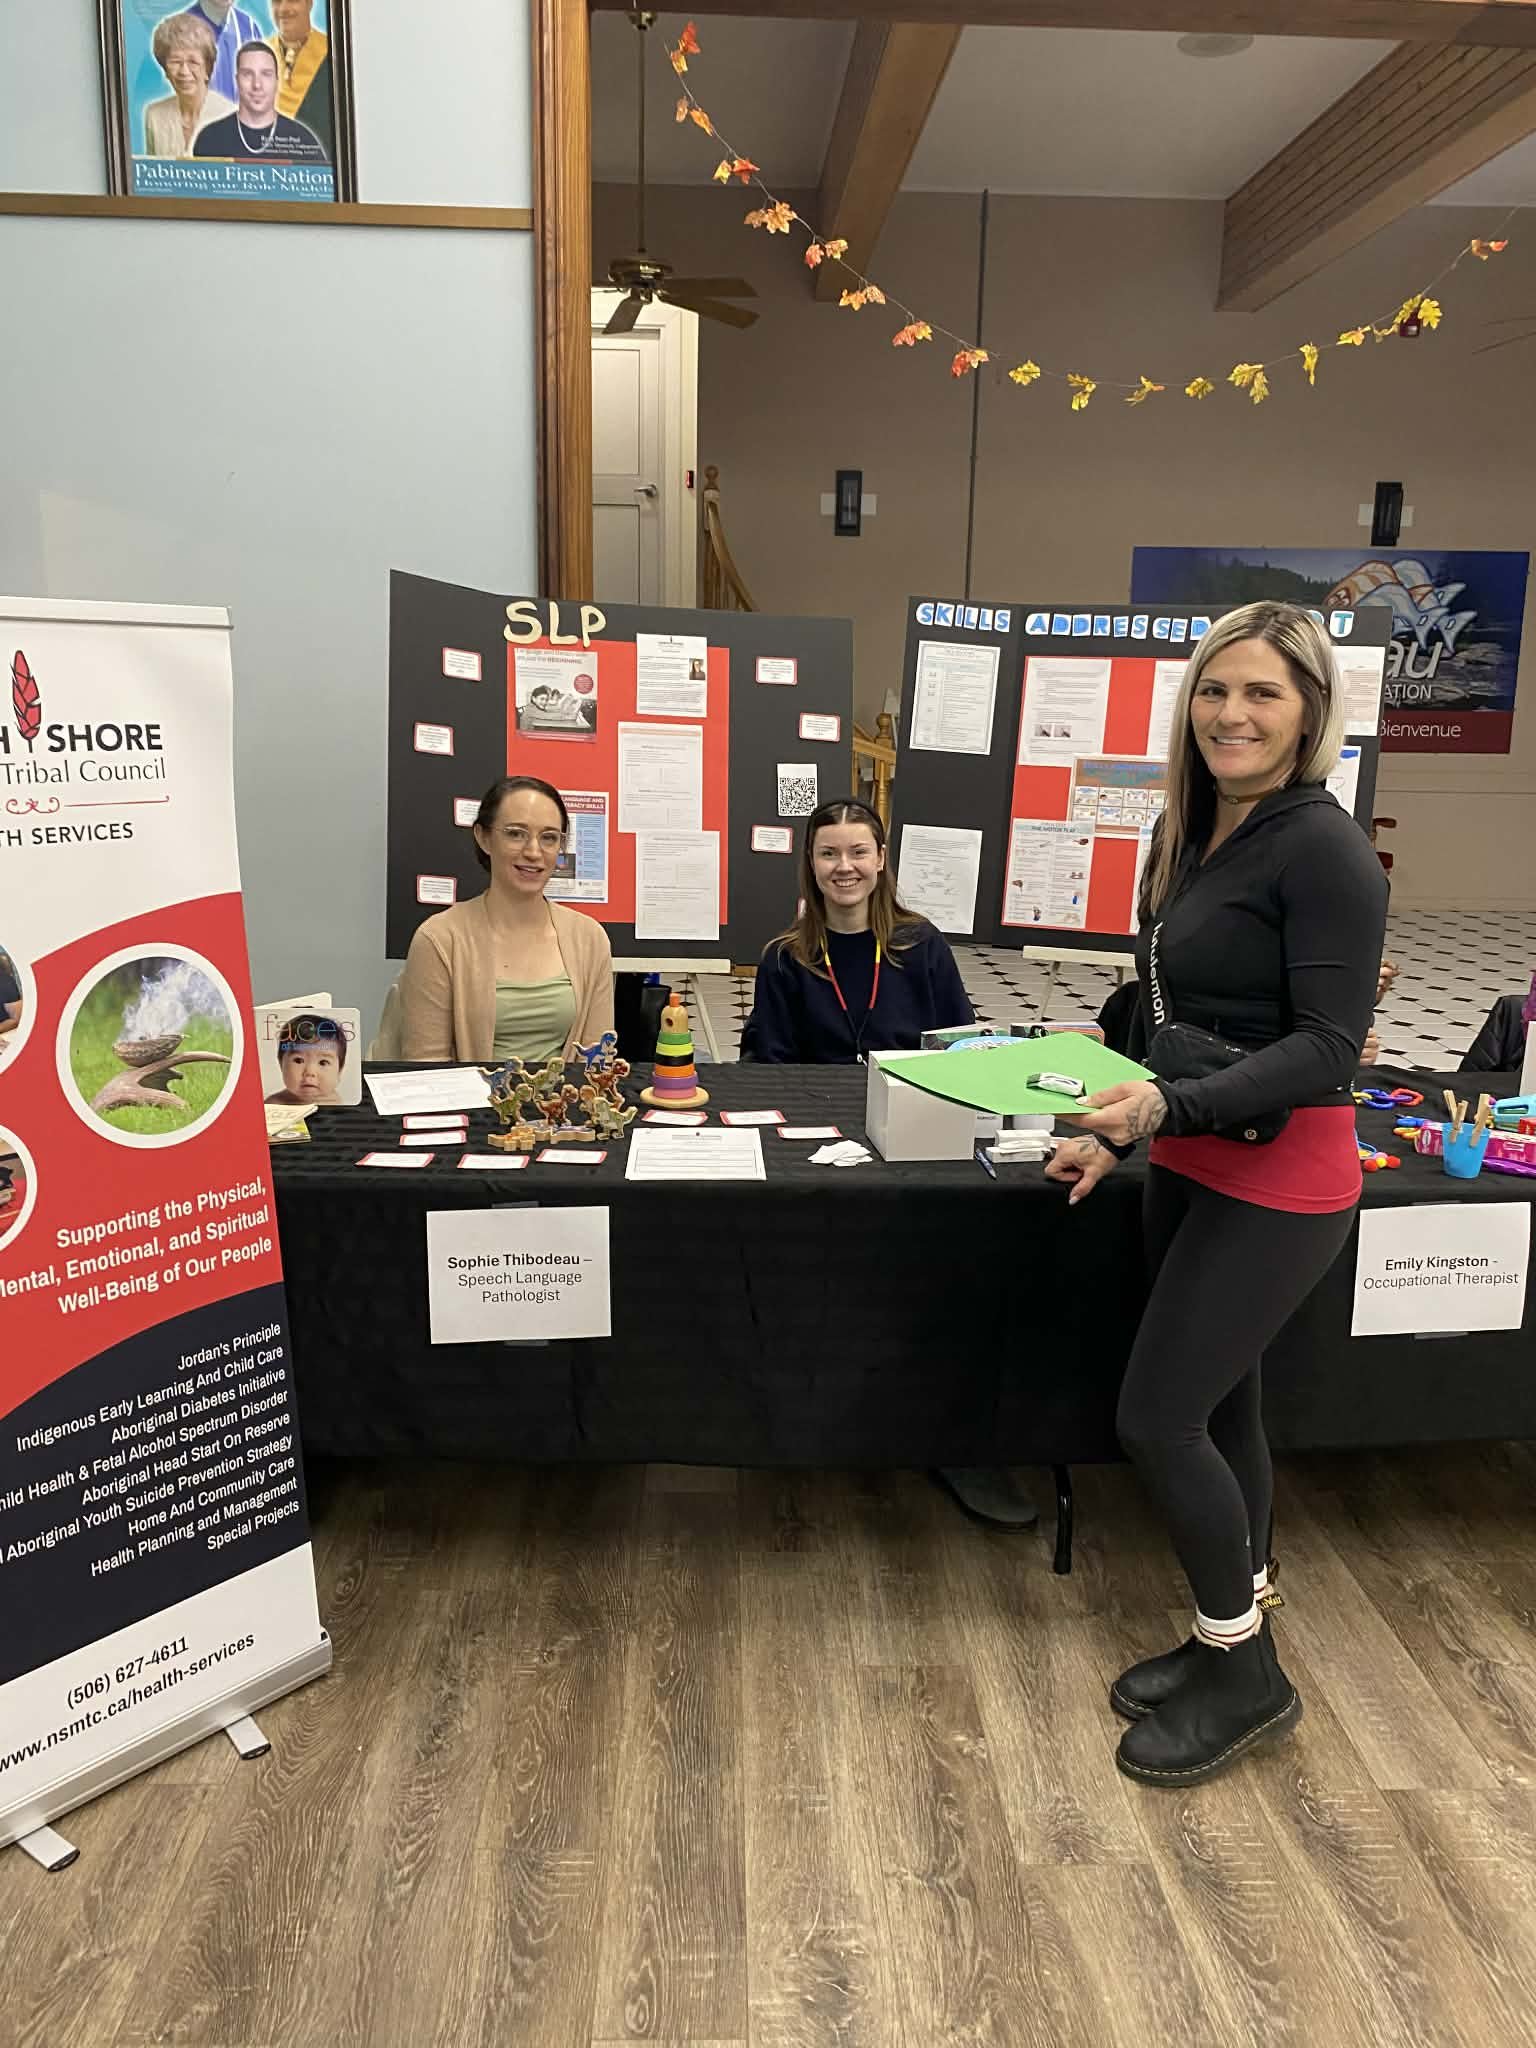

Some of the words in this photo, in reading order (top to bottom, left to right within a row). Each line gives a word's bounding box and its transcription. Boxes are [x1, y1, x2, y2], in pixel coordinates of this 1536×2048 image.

[135, 163, 218, 183] Pabineau
[225, 166, 264, 182] First
[272, 167, 334, 185] Nation
[503, 600, 607, 648] SLP
[919, 604, 1010, 631] SKILLS
[1029, 614, 1207, 641] ADDRESSED
[1384, 684, 1432, 699] ATION
[47, 723, 163, 753] SHORE
[0, 759, 70, 785] Tribal
[79, 757, 166, 782] Council
[31, 822, 134, 845] SERVICES
[262, 1013, 356, 1042] faces
[56, 1207, 161, 1248] Supporting
[164, 1200, 193, 1220] the
[197, 1176, 266, 1212] Physical,
[66, 1237, 164, 1280] Emotional,
[168, 1226, 202, 1251] and
[206, 1205, 269, 1242] Spiritual
[447, 1254, 500, 1270] Sophie
[503, 1252, 580, 1267] Thibodeau
[1385, 1257, 1423, 1271] Emily
[1427, 1256, 1489, 1270] Kingston
[58, 1273, 159, 1314] Well-Being
[163, 1264, 181, 1284] of
[185, 1257, 217, 1277] Our
[221, 1236, 272, 1267] People
[458, 1271, 512, 1288] Speech
[516, 1270, 582, 1286] Language
[482, 1289, 561, 1304] Pathologist
[1363, 1274, 1451, 1290] Occupational
[1456, 1272, 1519, 1288] Therapist
[177, 1342, 230, 1371] Jordan's
[232, 1322, 281, 1351] Principle
[17, 1414, 96, 1452] Indigenous
[100, 1399, 134, 1424] Early
[137, 1377, 194, 1409] Learning
[196, 1371, 221, 1389] And
[224, 1355, 255, 1378] Child
[257, 1346, 283, 1364] Care
[111, 1410, 178, 1444] Aboriginal
[181, 1389, 236, 1418] Diabetes
[239, 1368, 286, 1397] Initiative
[28, 1471, 75, 1501] Health
[78, 1466, 90, 1481] &
[93, 1451, 127, 1476] Fetal
[129, 1433, 176, 1462] Alcohol
[179, 1413, 237, 1442] Spectrum
[241, 1391, 288, 1418] Disorder
[82, 1469, 150, 1505] Aboriginal
[154, 1451, 188, 1476] Head
[191, 1443, 221, 1462] Start
[224, 1434, 242, 1449] On
[245, 1415, 291, 1441] Reserve
[7, 1520, 80, 1562] Aboriginal
[83, 1504, 123, 1529] Youth
[126, 1482, 175, 1512] Suicide
[178, 1456, 244, 1491] Prevention
[247, 1433, 293, 1461] Strategy
[128, 1514, 167, 1536] Home
[170, 1500, 195, 1519] And
[198, 1469, 265, 1506] Community
[268, 1457, 295, 1477] Care
[91, 1549, 135, 1577] Health
[138, 1522, 195, 1556] Planning
[198, 1509, 221, 1531] and
[224, 1477, 298, 1518] Management
[207, 1523, 252, 1550] Special
[255, 1500, 299, 1530] Projects
[67, 1673, 111, 1710] (506)
[115, 1636, 189, 1684] 627-4611
[0, 1632, 255, 1773] www.nsmtc.ca/health-services
